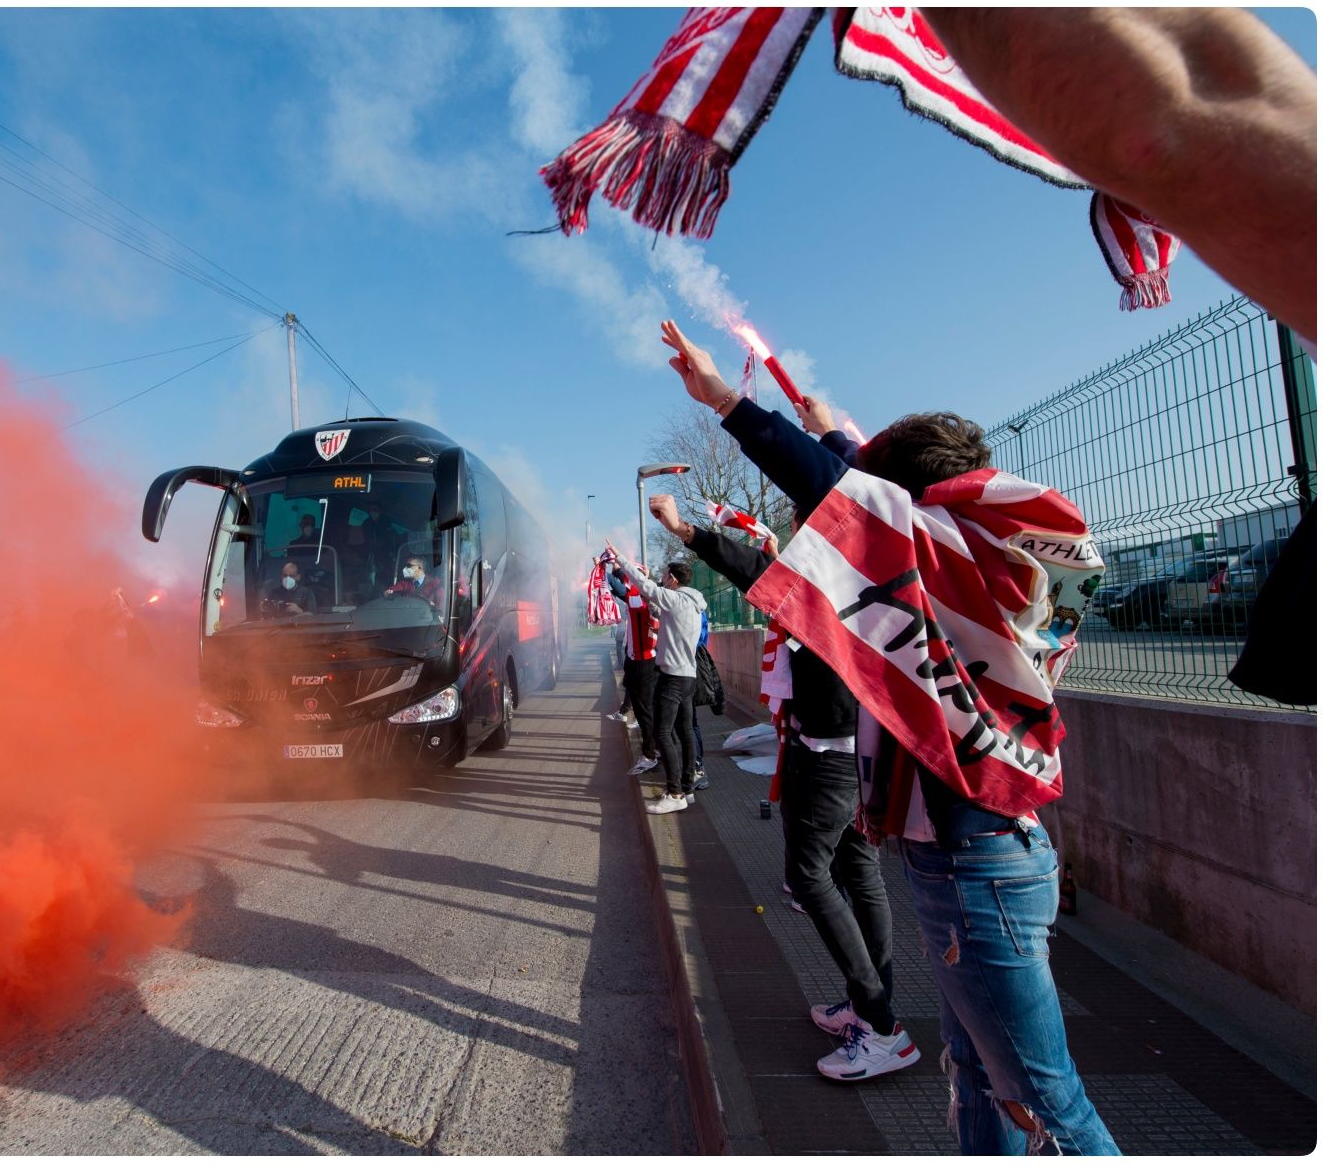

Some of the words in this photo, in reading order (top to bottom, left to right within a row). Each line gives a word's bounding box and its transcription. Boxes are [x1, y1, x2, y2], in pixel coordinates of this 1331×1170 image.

[334, 476, 367, 488] ATHL
[294, 712, 332, 721] SCANIA
[290, 745, 317, 758] 0670
[319, 743, 340, 757] HCX
